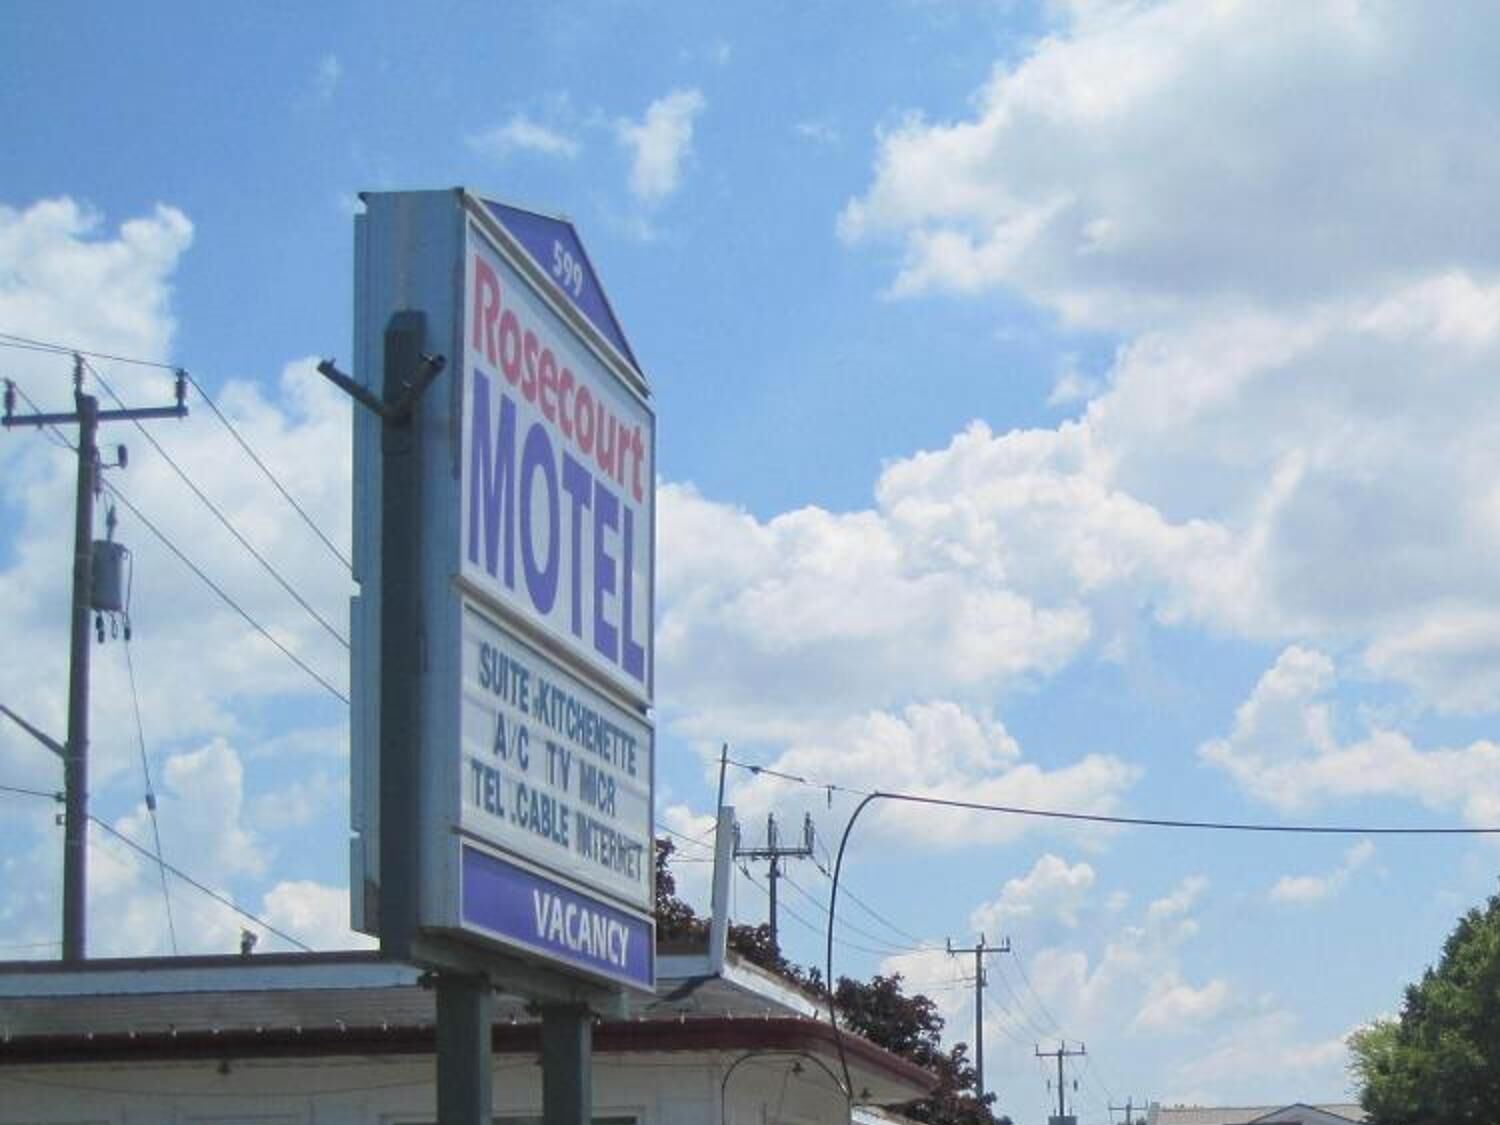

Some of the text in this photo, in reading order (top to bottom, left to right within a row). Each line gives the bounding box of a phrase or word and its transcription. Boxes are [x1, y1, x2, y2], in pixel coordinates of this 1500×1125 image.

[553, 239, 583, 298] 599
[472, 254, 644, 504] Rosecourt
[468, 367, 645, 683] MOTEL
[479, 641, 530, 714] SUITE
[494, 711, 530, 772] A/C
[546, 740, 571, 793] TV
[575, 811, 643, 882] INTERNET
[533, 888, 630, 968] VACANCY
